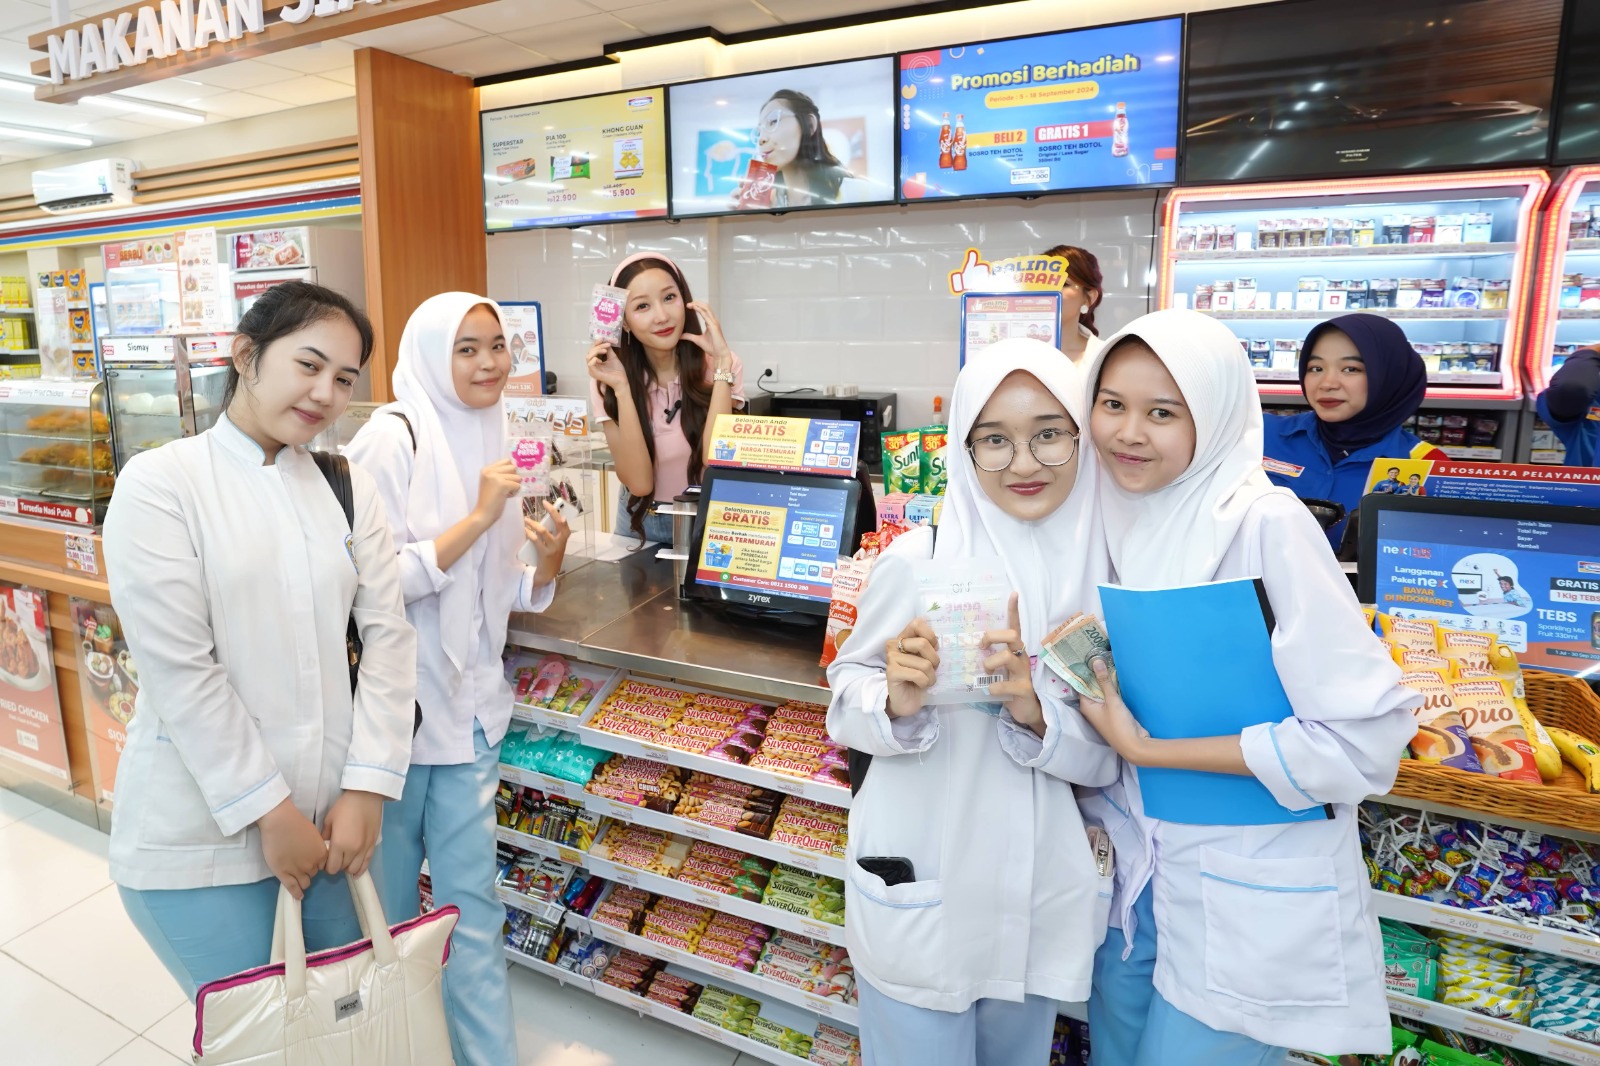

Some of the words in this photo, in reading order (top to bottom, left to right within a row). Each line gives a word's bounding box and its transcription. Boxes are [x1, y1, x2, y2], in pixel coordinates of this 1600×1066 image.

[48, 0, 265, 85] MAKANAN
[951, 65, 1031, 91] Promosi
[1032, 53, 1140, 82] Berhadiah
[989, 95, 1014, 103] Periode
[1038, 88, 1075, 99] September
[1076, 86, 1095, 94] 2024
[602, 126, 624, 134] KHONG
[625, 124, 644, 132] GUAN
[1038, 125, 1081, 141] GRATIS
[1082, 124, 1089, 137] 1
[993, 132, 1015, 144] BELI
[1015, 130, 1024, 142] 2
[492, 139, 524, 148] SUPERSTAR
[127, 343, 149, 352] Siomay
[735, 417, 768, 425] Belanjaan
[733, 423, 786, 436] GRATIS
[740, 446, 762, 454] HARGA
[763, 447, 796, 455] TERMURAH
[888, 440, 905, 450] 30%
[1450, 467, 1518, 477] KOSAKATA
[1522, 470, 1600, 481] PELAYANAN
[20, 502, 43, 514] Tersedia
[43, 506, 56, 516] Nasi
[56, 509, 72, 518] Putih
[725, 506, 754, 514] Belanjaan
[722, 511, 770, 526] GRATIS
[708, 533, 734, 542] HARGA
[735, 536, 776, 547] TERMURAH
[1383, 545, 1408, 555] nex
[1394, 565, 1444, 577] Langganan
[732, 575, 756, 583] Customer
[756, 578, 770, 586] Care:
[770, 580, 783, 588] 0811
[1391, 575, 1416, 585] Paket
[1417, 577, 1448, 589] nex
[1556, 579, 1600, 590] GRATIS
[1403, 586, 1434, 596] BAYAR
[748, 593, 771, 603] zyrex
[1395, 594, 1454, 608] INDOMARET
[829, 608, 855, 627] Kacang
[1536, 608, 1577, 623] TEBS
[1537, 623, 1572, 633] Sparkling
[1554, 632, 1578, 640] 330ml
[1477, 699, 1504, 707] Prime
[1459, 707, 1514, 730] Duo
[638, 783, 660, 795] CHUNKY
[542, 800, 576, 814] Alkaline
[540, 863, 565, 875] Panasonic
[1450, 919, 1479, 929] 2.000
[1502, 930, 1533, 941] 2.600
